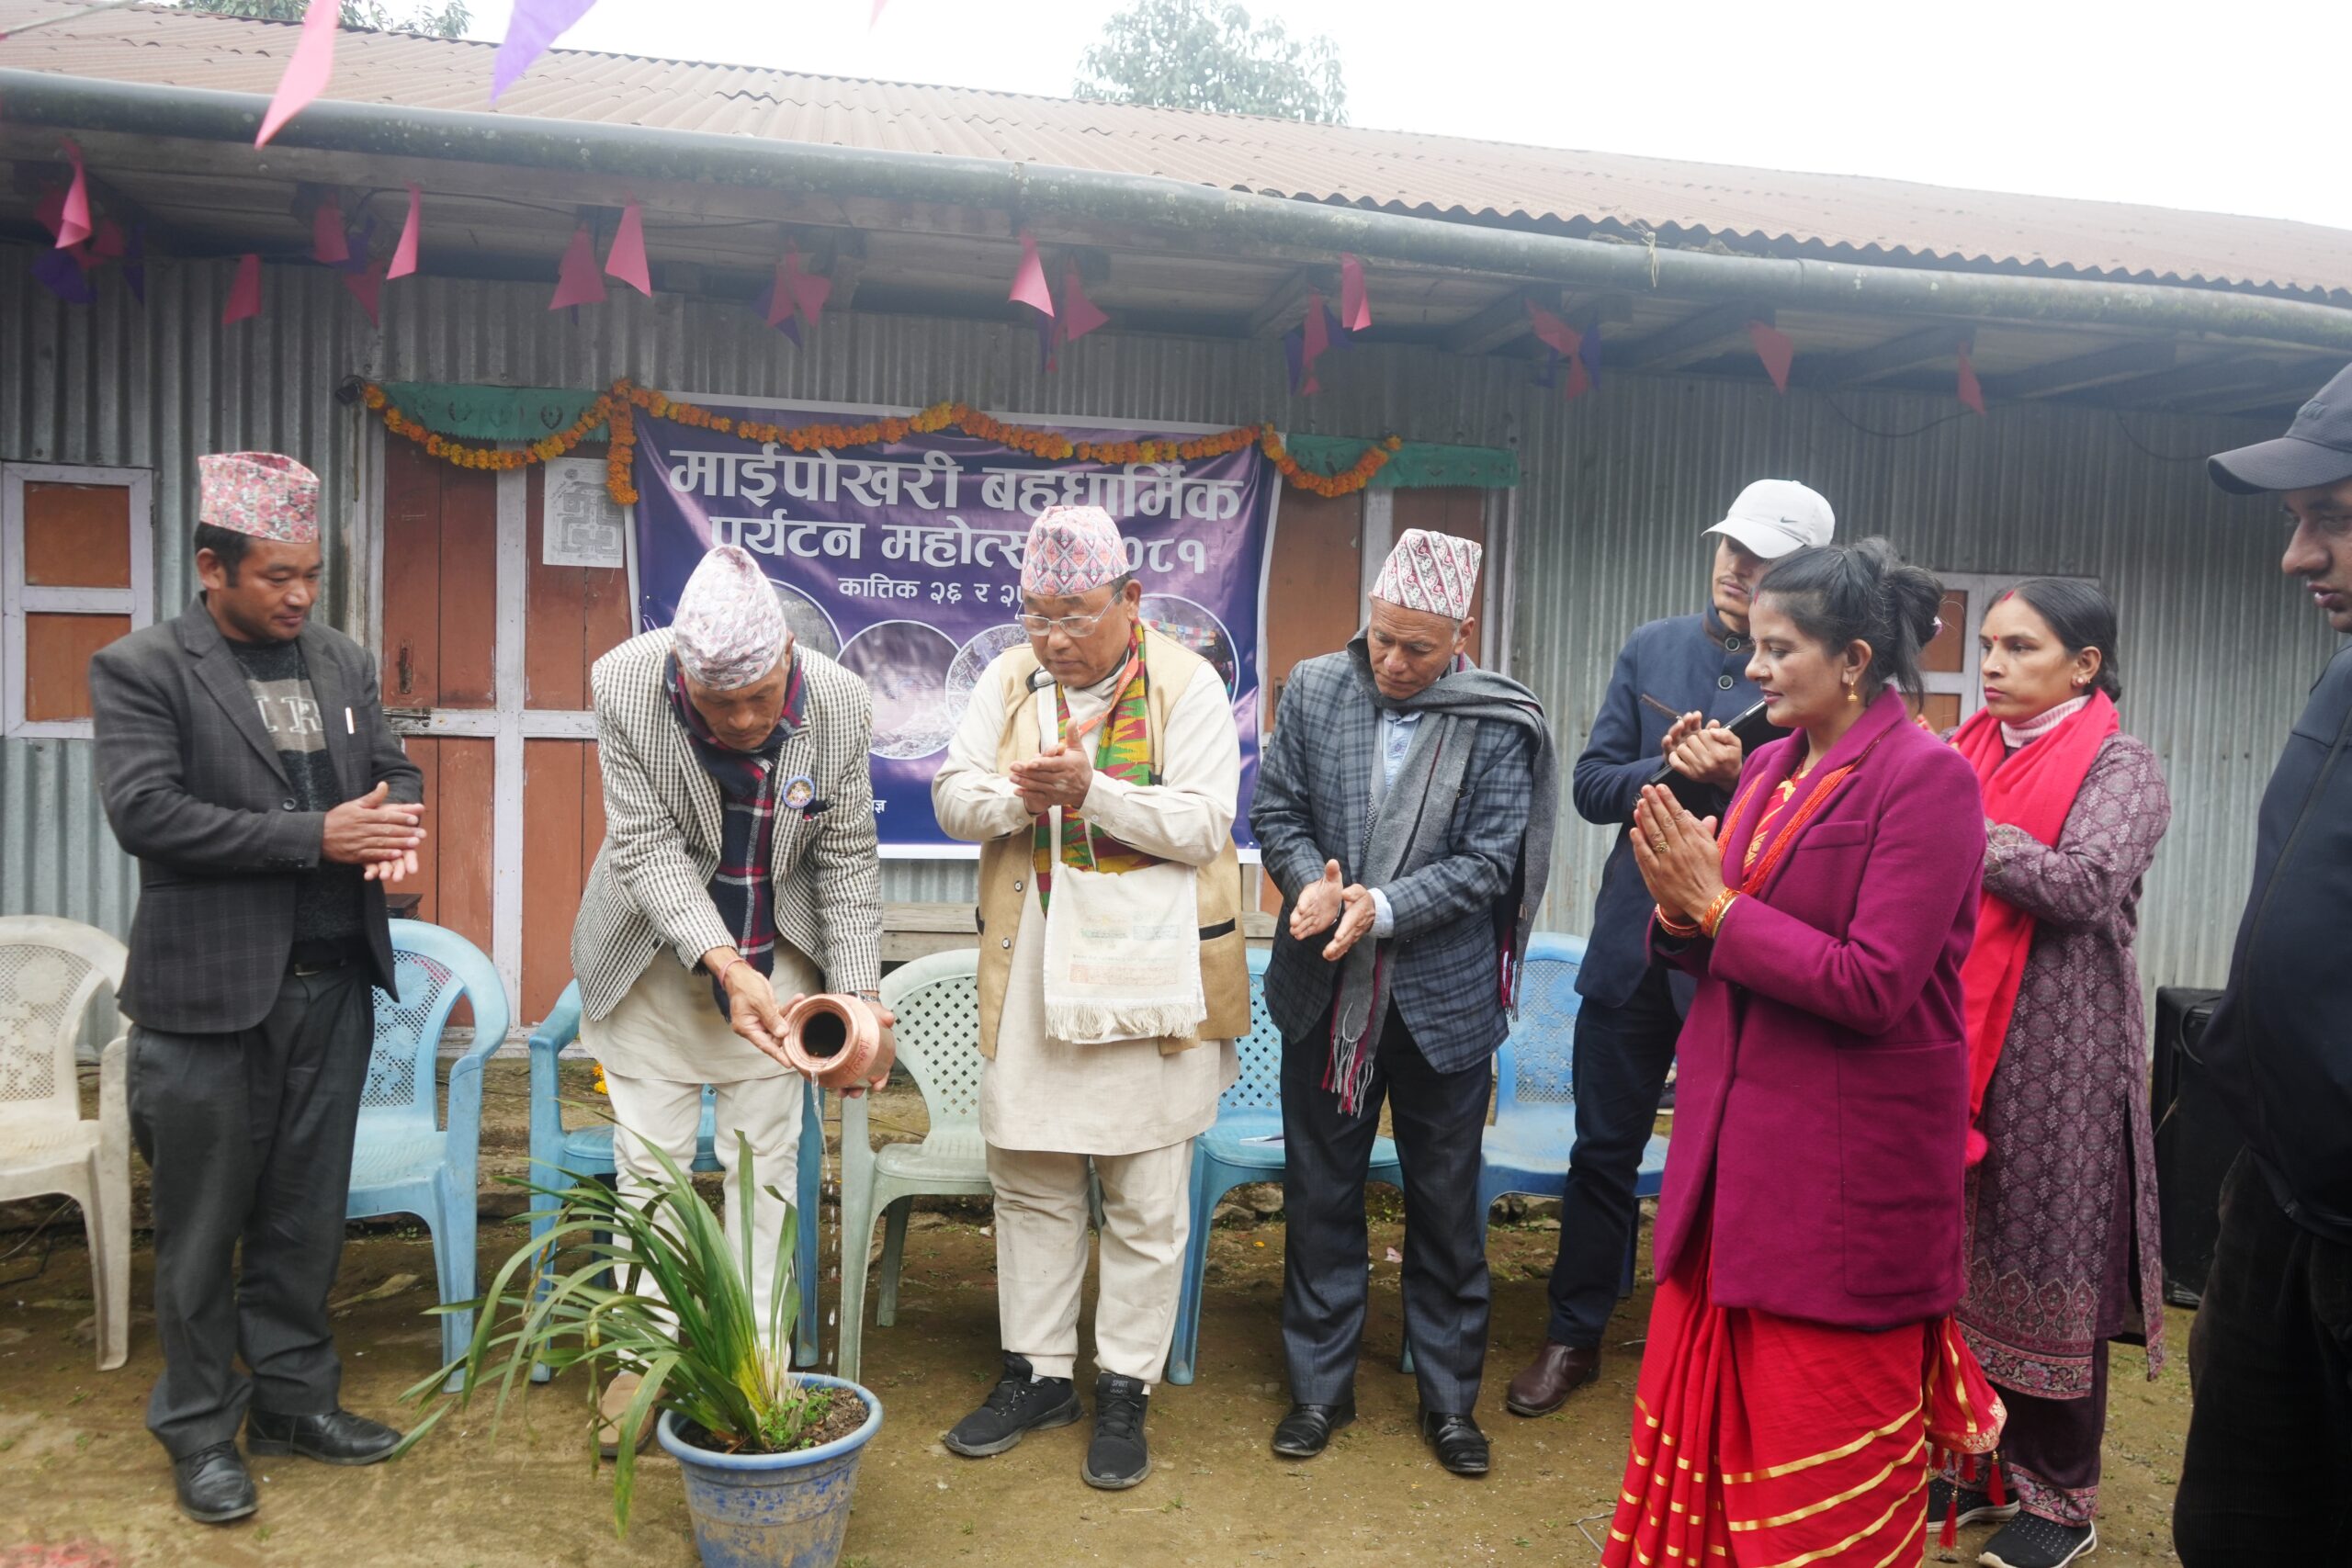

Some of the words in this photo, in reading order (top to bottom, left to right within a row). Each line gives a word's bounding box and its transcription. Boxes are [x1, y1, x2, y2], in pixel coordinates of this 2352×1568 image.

[669, 442, 964, 511] माईपोखरी
[708, 508, 866, 559] पर्यटन
[930, 581, 962, 604] २६
[974, 583, 990, 603] र
